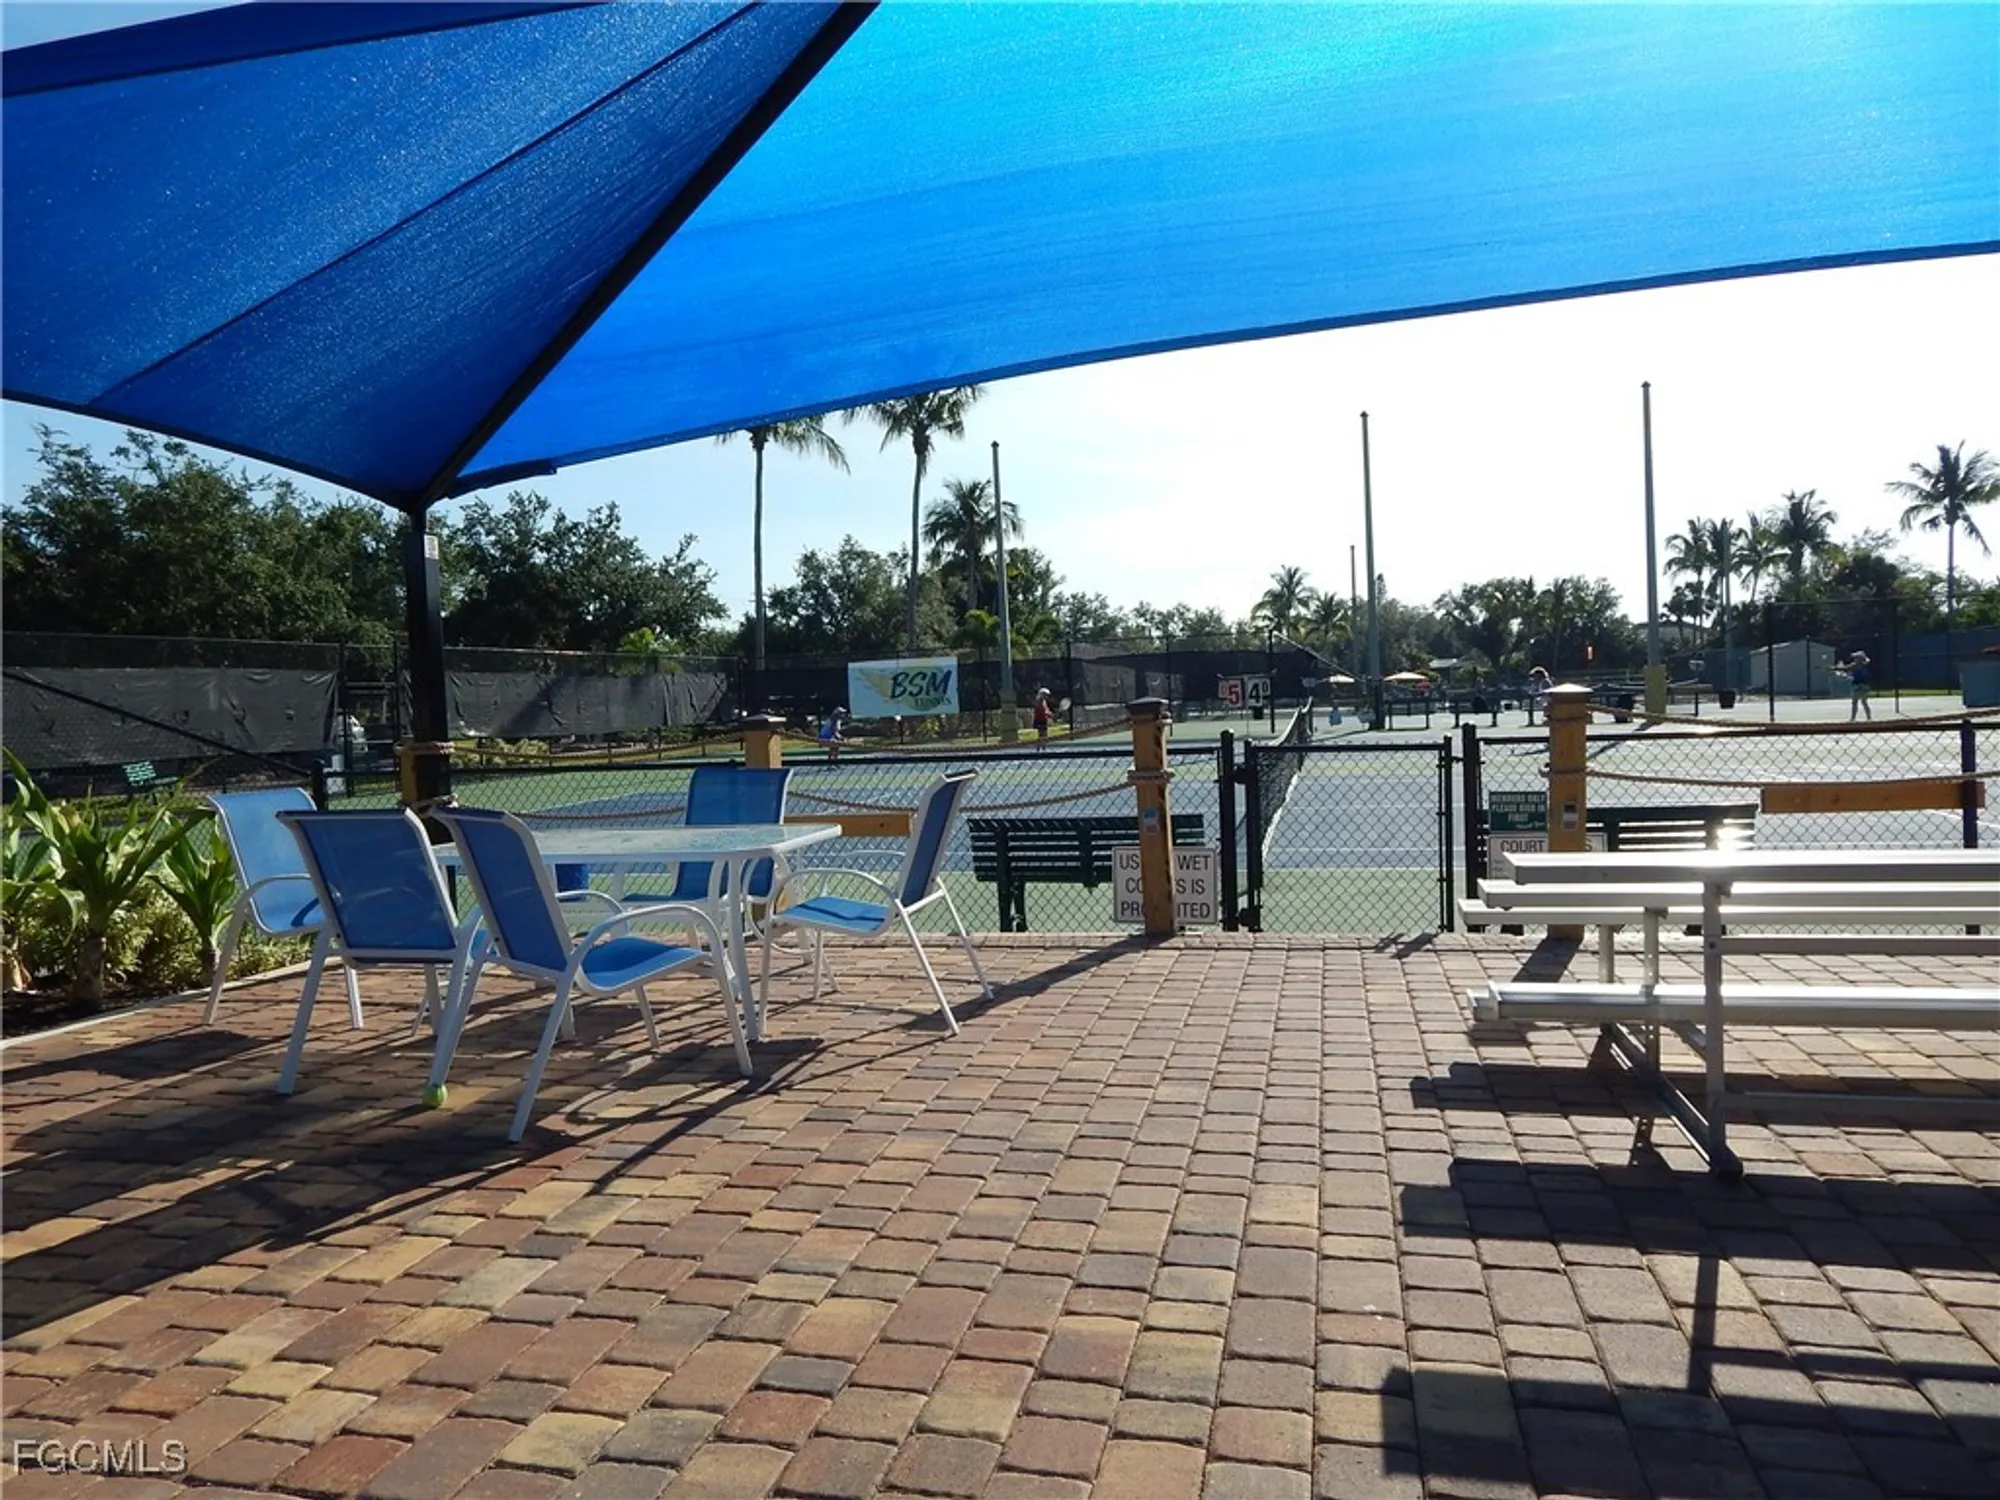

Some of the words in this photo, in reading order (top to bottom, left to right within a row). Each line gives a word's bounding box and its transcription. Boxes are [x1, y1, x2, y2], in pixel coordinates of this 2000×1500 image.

[890, 669, 952, 699] BSM
[1228, 684, 1240, 704] 5
[1249, 683, 1260, 703] 4
[1500, 840, 1545, 852] COURT
[1119, 854, 1140, 870] US
[1176, 855, 1210, 870] WET
[1125, 877, 1187, 894] COS
[1192, 879, 1205, 894] IS
[1121, 901, 1210, 918] PRITED
